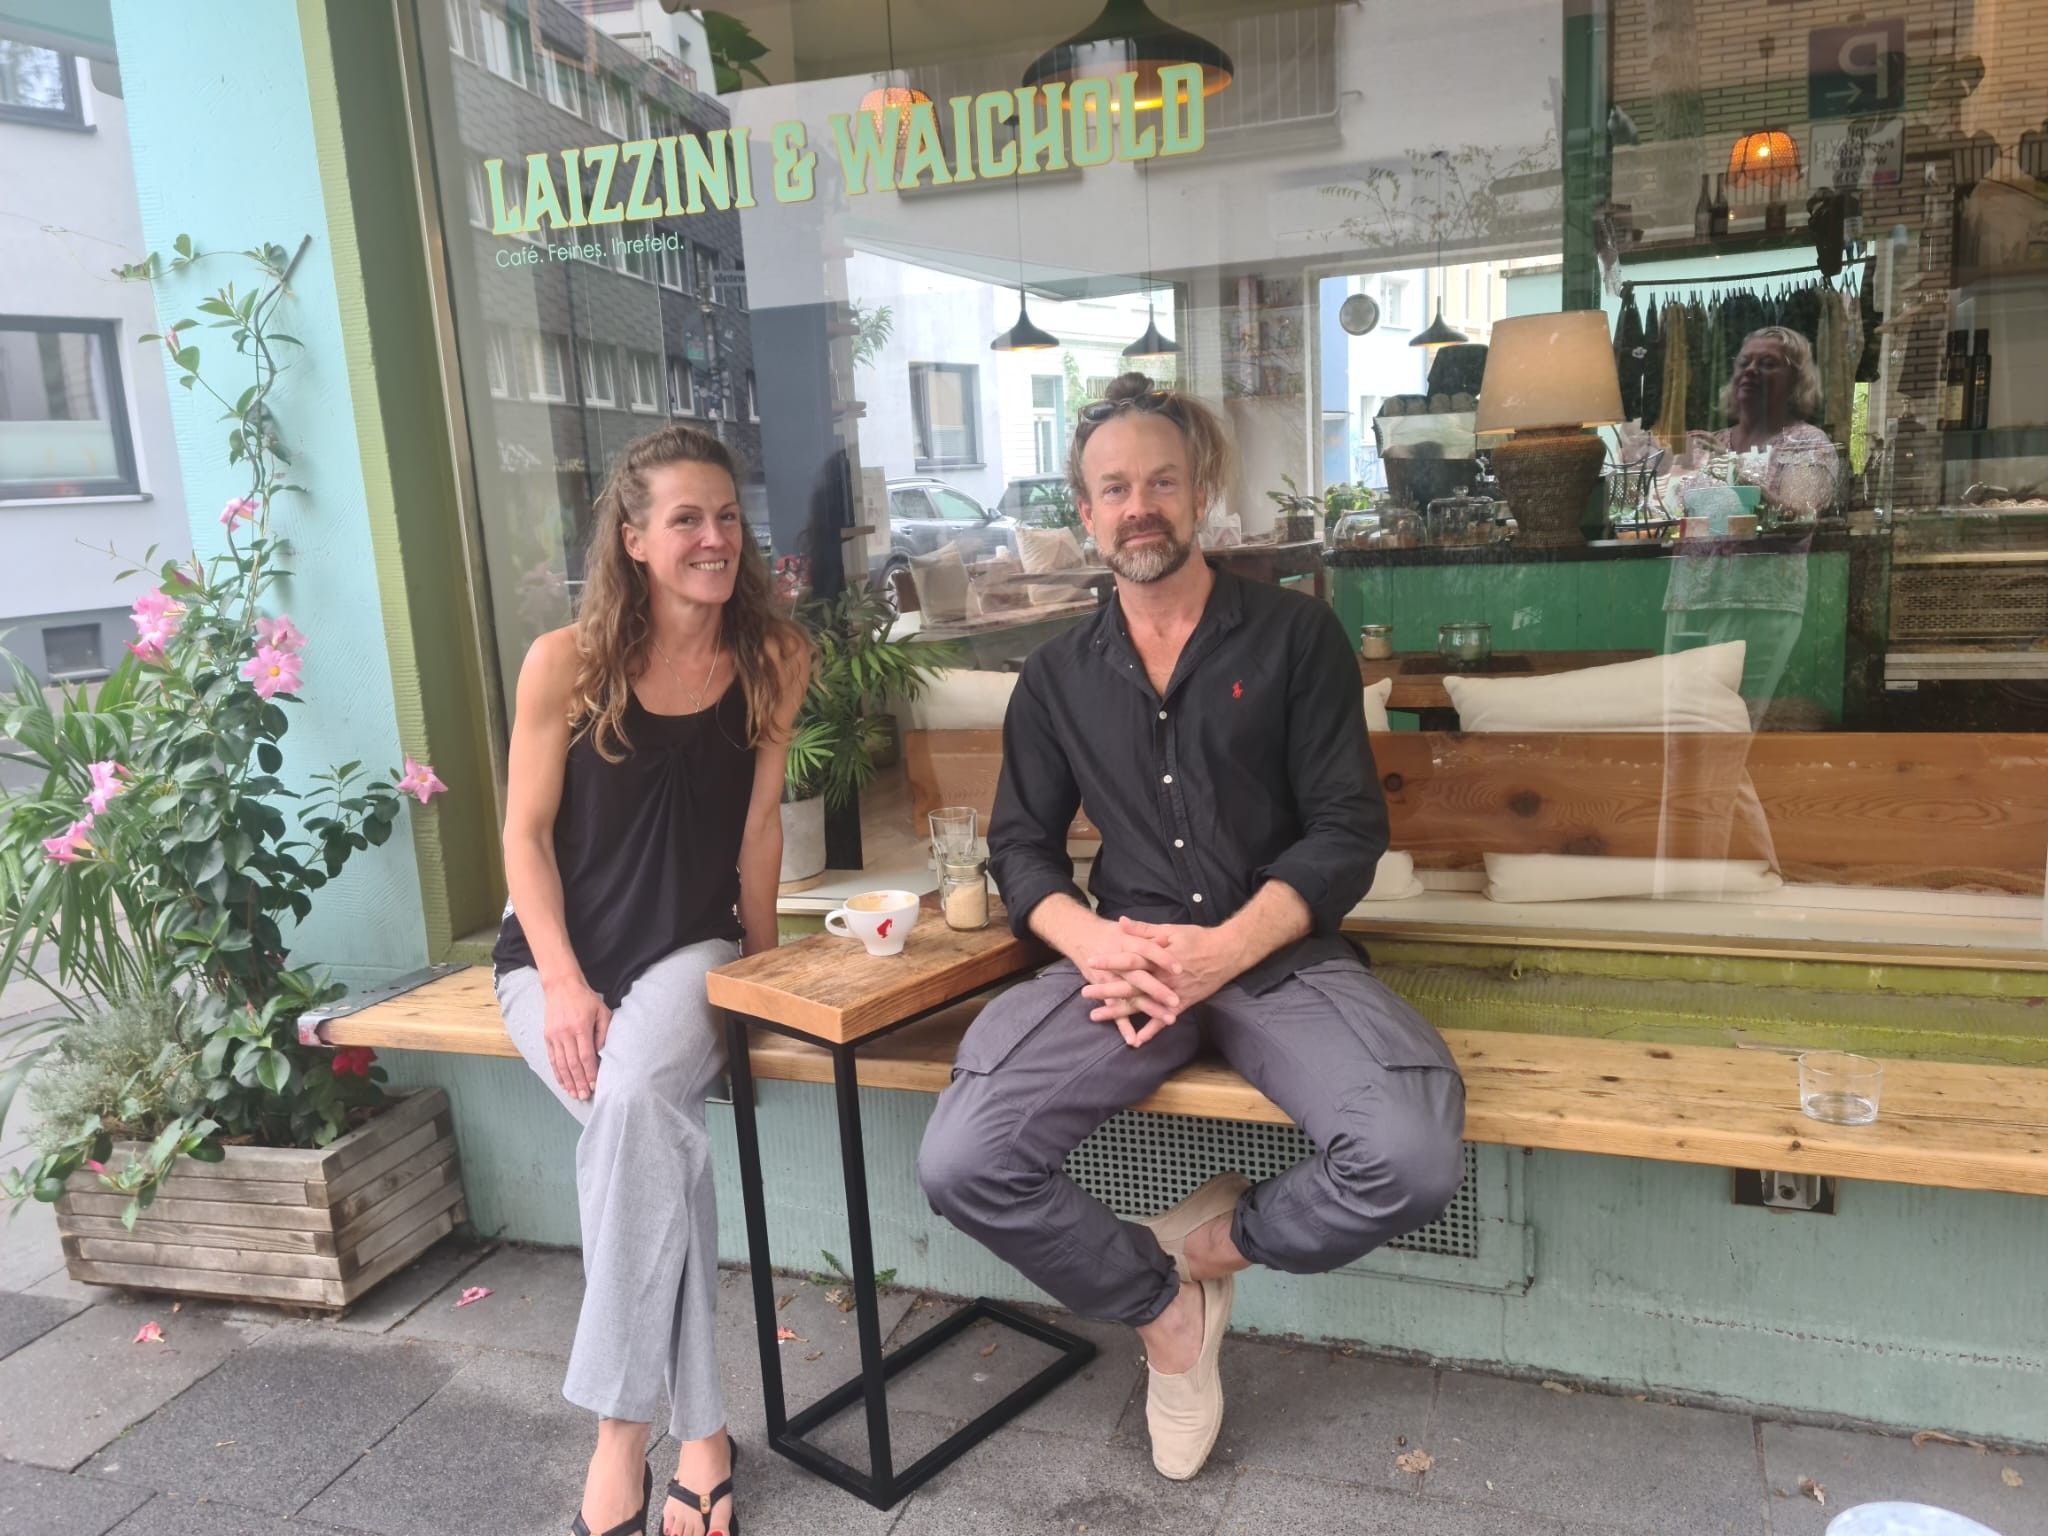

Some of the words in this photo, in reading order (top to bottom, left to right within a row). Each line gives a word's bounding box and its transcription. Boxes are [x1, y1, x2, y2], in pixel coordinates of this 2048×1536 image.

[485, 126, 756, 235] LAIZZINI
[771, 120, 818, 203] &
[829, 62, 1205, 196] WAICHOLD
[495, 245, 544, 268] Café.
[548, 241, 607, 262] Feines.
[612, 231, 684, 256] Ihrefeld.
